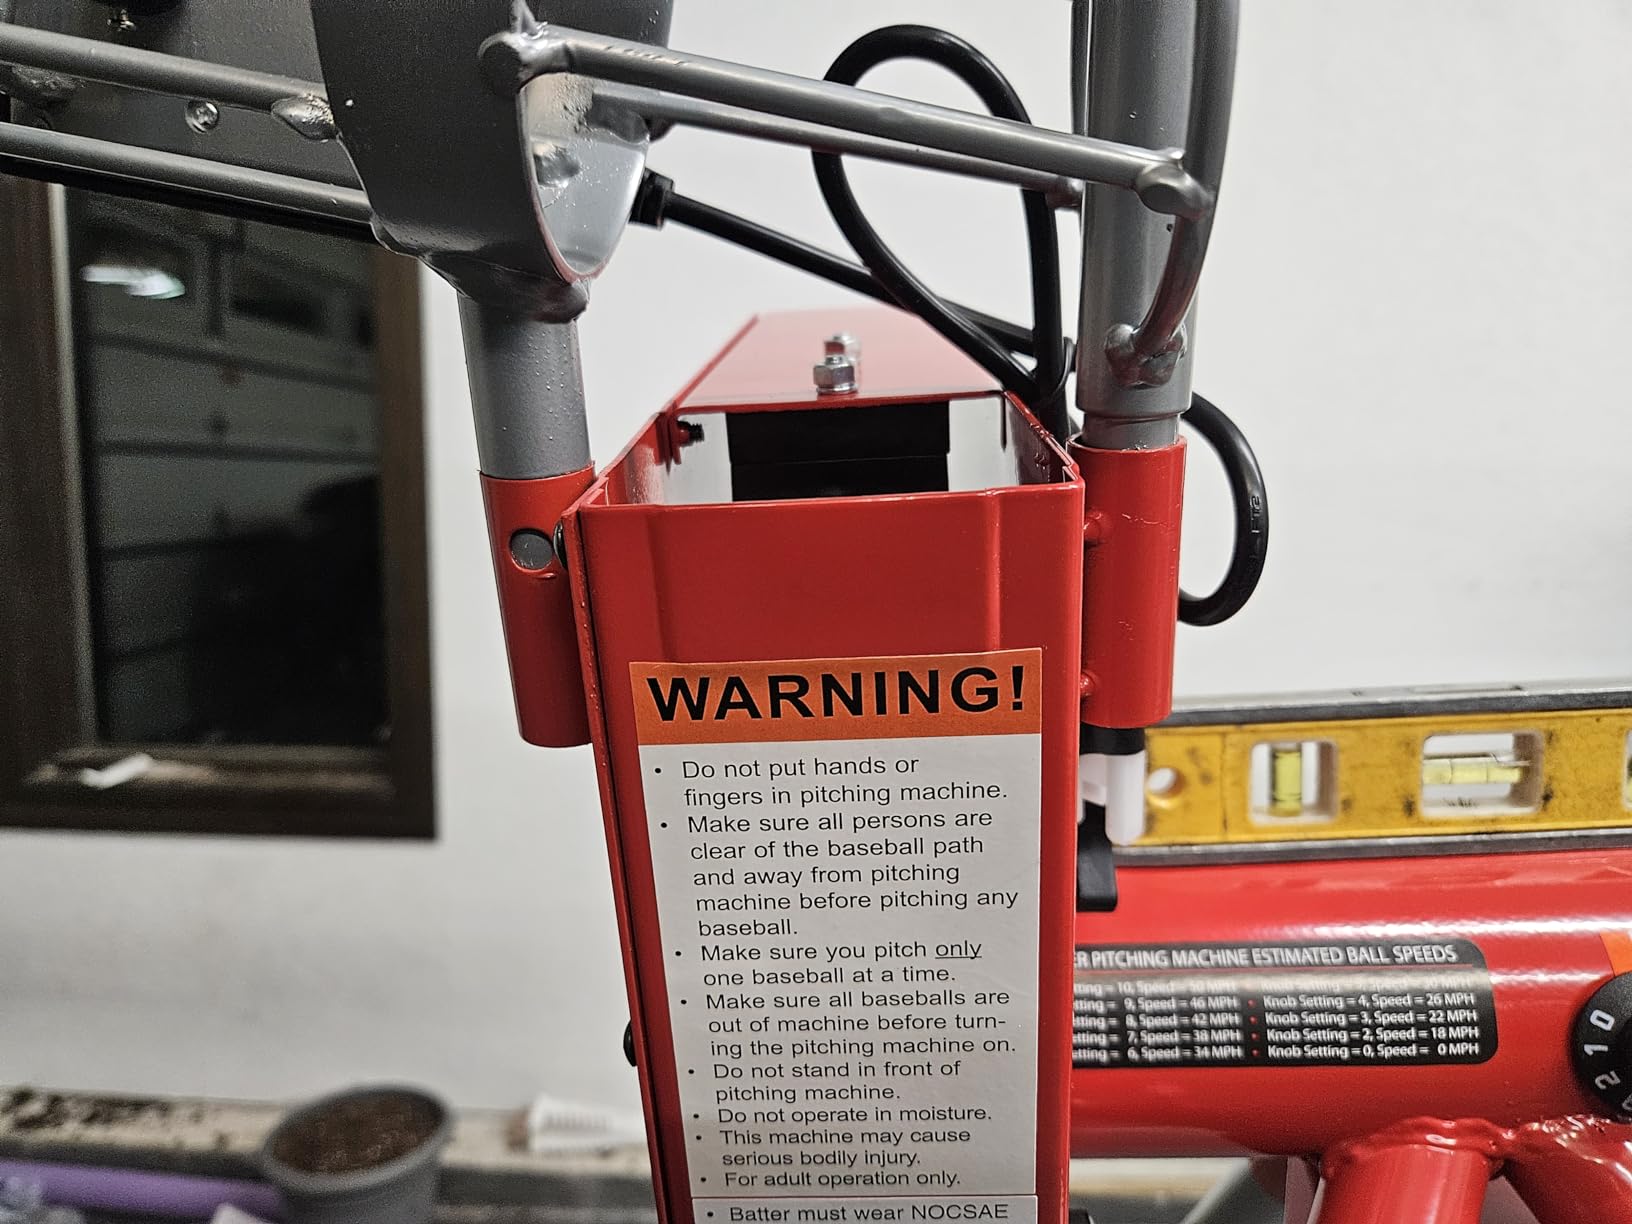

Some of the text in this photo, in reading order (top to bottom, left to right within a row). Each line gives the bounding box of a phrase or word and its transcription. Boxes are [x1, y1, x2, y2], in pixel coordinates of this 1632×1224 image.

[646, 665, 1024, 722] WARNING!
[683, 756, 919, 781] Do not put hands or
[684, 782, 1008, 809] fingers in pitching machine.
[688, 812, 993, 833] Make sure all persons are
[691, 836, 983, 859] clear of the baseball path
[694, 864, 959, 889] and away from pitching
[697, 889, 1018, 911] machine before pitching any
[699, 919, 797, 936] baseball.
[701, 940, 982, 963] Make sure you pitch only
[1074, 945, 1457, 968] R PITCHING MACHINE ESTIMATED BALL SPEEDS
[704, 966, 955, 986] one baseball at a time.
[707, 989, 1009, 1012] Make sure all baseballs are
[1137, 998, 1176, 1013] Speed
[1190, 997, 1205, 1010] 46
[1207, 996, 1237, 1008] MPH
[1263, 995, 1296, 1009] Knob
[1299, 994, 1344, 1009] Setting
[1371, 993, 1412, 1009] Speed
[1426, 993, 1442, 1006] 26
[1444, 993, 1475, 1006] MPH
[709, 1012, 1006, 1033] out of machine before turn-
[1138, 1013, 1178, 1029] Speed
[1191, 1013, 1207, 1026] 42
[1209, 1012, 1239, 1025] MPH
[1265, 1012, 1298, 1025] Knob
[1300, 1011, 1346, 1027] Setting
[1374, 1010, 1414, 1026] Speed
[1429, 1010, 1445, 1023] 22
[1447, 1010, 1478, 1022] MPH
[1590, 1009, 1615, 1031] 0
[1140, 1029, 1179, 1045] Speed
[1193, 1029, 1208, 1042] 38
[1211, 1028, 1241, 1041] MPH
[1267, 1029, 1300, 1042] Knob
[1303, 1028, 1348, 1044] Setting
[1376, 1027, 1416, 1043] Speed
[1431, 1027, 1446, 1039] 18
[1449, 1026, 1479, 1039] MPH
[711, 1037, 1015, 1059] ing the pitching machine on.
[1141, 1047, 1181, 1062] Speed
[1194, 1047, 1210, 1059] 34
[1212, 1045, 1242, 1059] MPH
[1268, 1045, 1301, 1058] Knob
[1304, 1044, 1349, 1060] Setting
[1377, 1044, 1416, 1059] Speed
[1438, 1043, 1446, 1055] 0
[1449, 1042, 1479, 1055] MPH
[1584, 1043, 1609, 1056] 1
[714, 1060, 961, 1079] Do not stand in front of
[1595, 1071, 1621, 1089] 2
[716, 1084, 900, 1104] pitching machine.
[718, 1106, 991, 1126] Do not operate in moisture.
[720, 1128, 970, 1147] This machine may cause
[723, 1149, 920, 1170] serious bodily injury.
[725, 1169, 960, 1188] For adult operation only.
[730, 1204, 1008, 1224] Batter must wear NOCSAE
